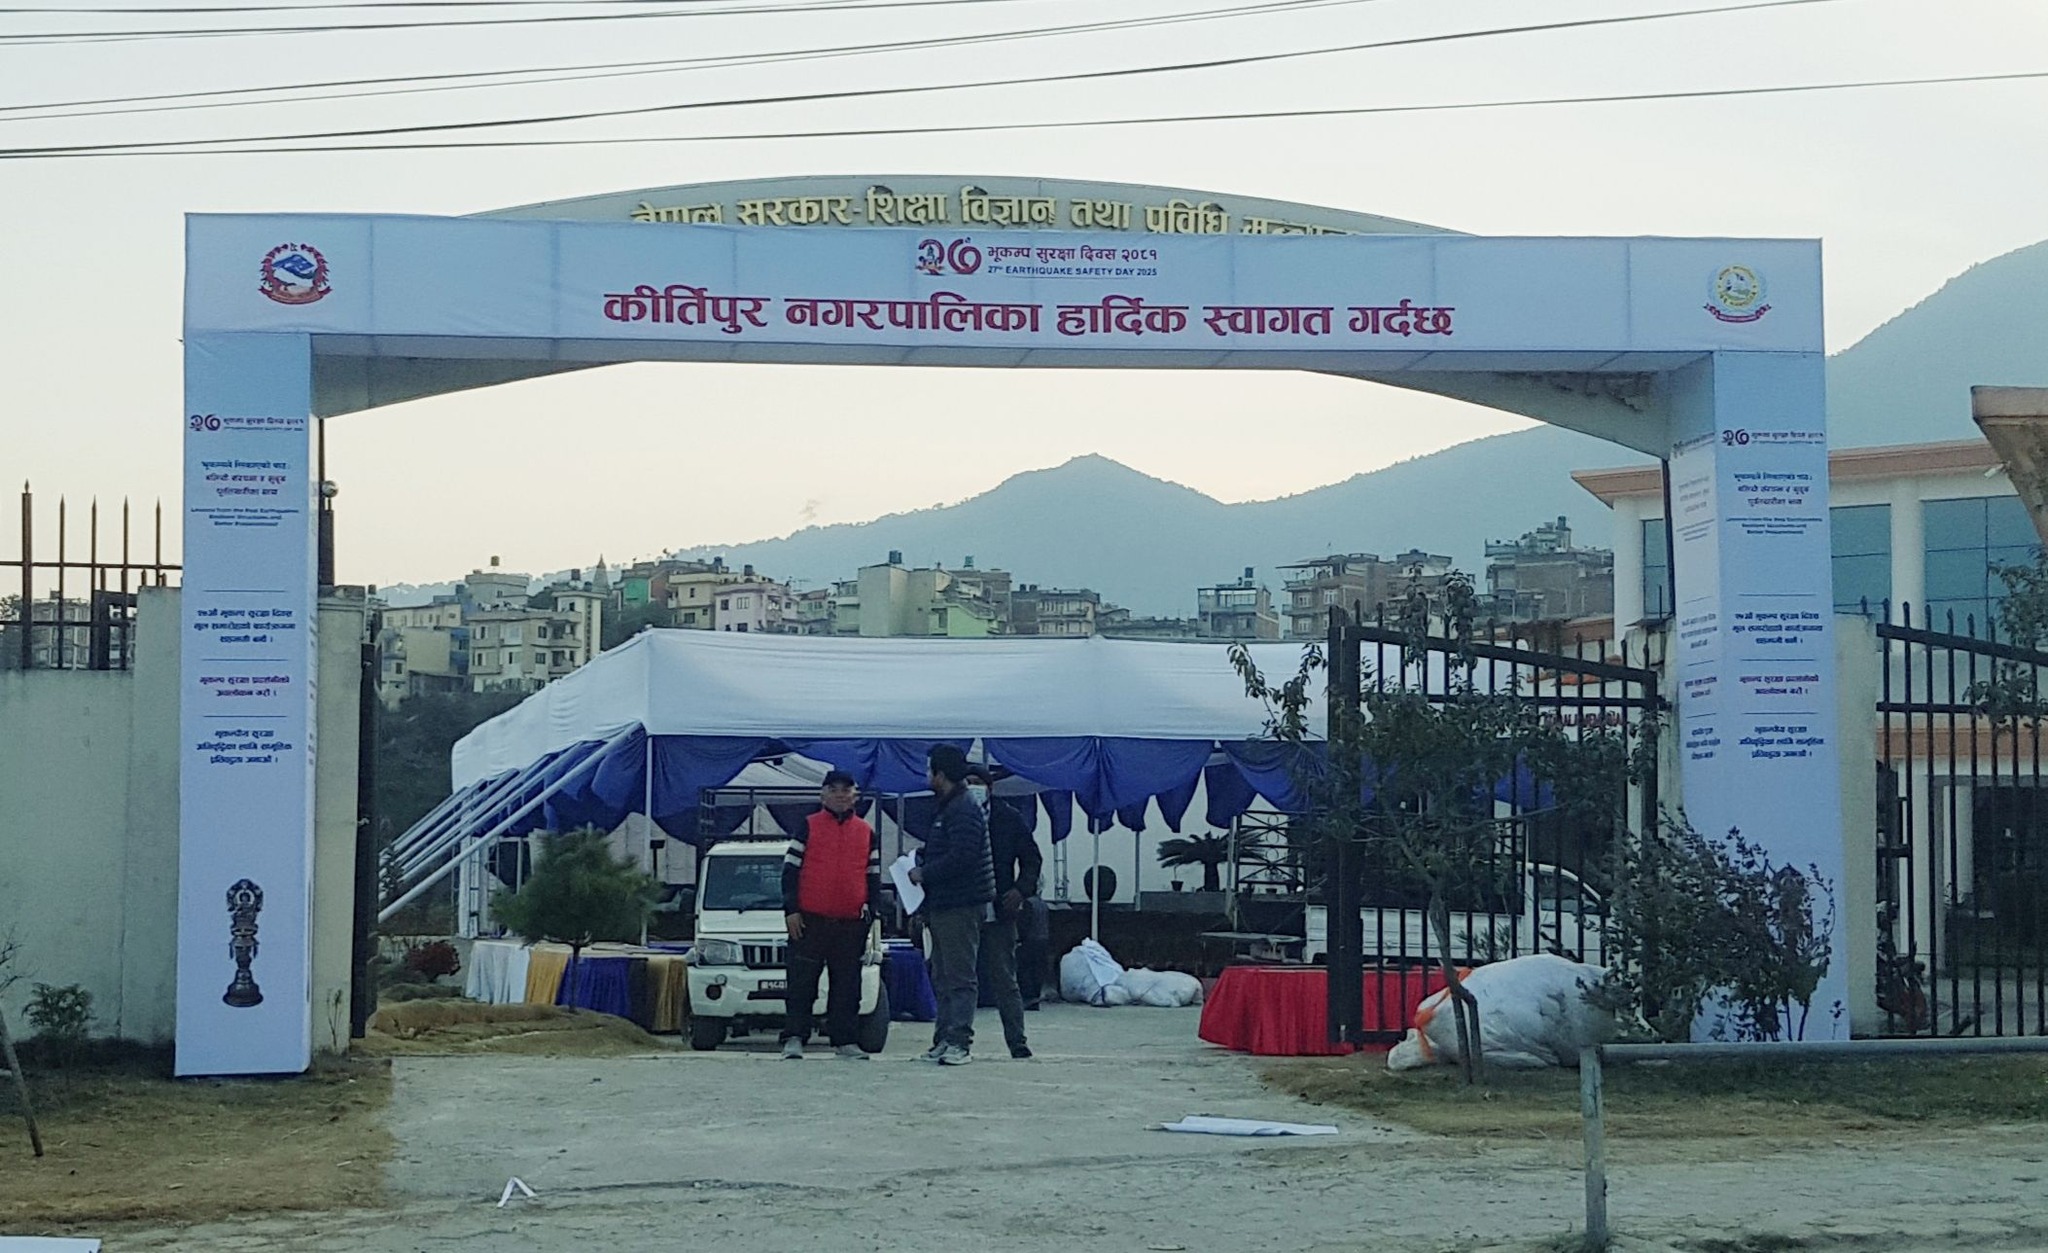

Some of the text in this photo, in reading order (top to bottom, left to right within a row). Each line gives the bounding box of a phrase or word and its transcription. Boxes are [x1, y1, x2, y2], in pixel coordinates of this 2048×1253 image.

[961, 186, 1055, 225] विज्ञान
[1071, 199, 1131, 228] तथा
[987, 246, 1031, 262] भूकम्प
[1036, 247, 1075, 263] सुरक्षा
[1081, 245, 1117, 261] दिवस
[1121, 249, 1157, 262] २०८१
[1006, 266, 1072, 275] EARTHQUAKE
[1075, 267, 1112, 275] SAFETY
[1115, 268, 1134, 276] DAY
[1137, 268, 1157, 276] 2025
[603, 284, 1455, 337] कीर्तिपुर नगरपालिका हार्दिक स्वागत गर्दछ
